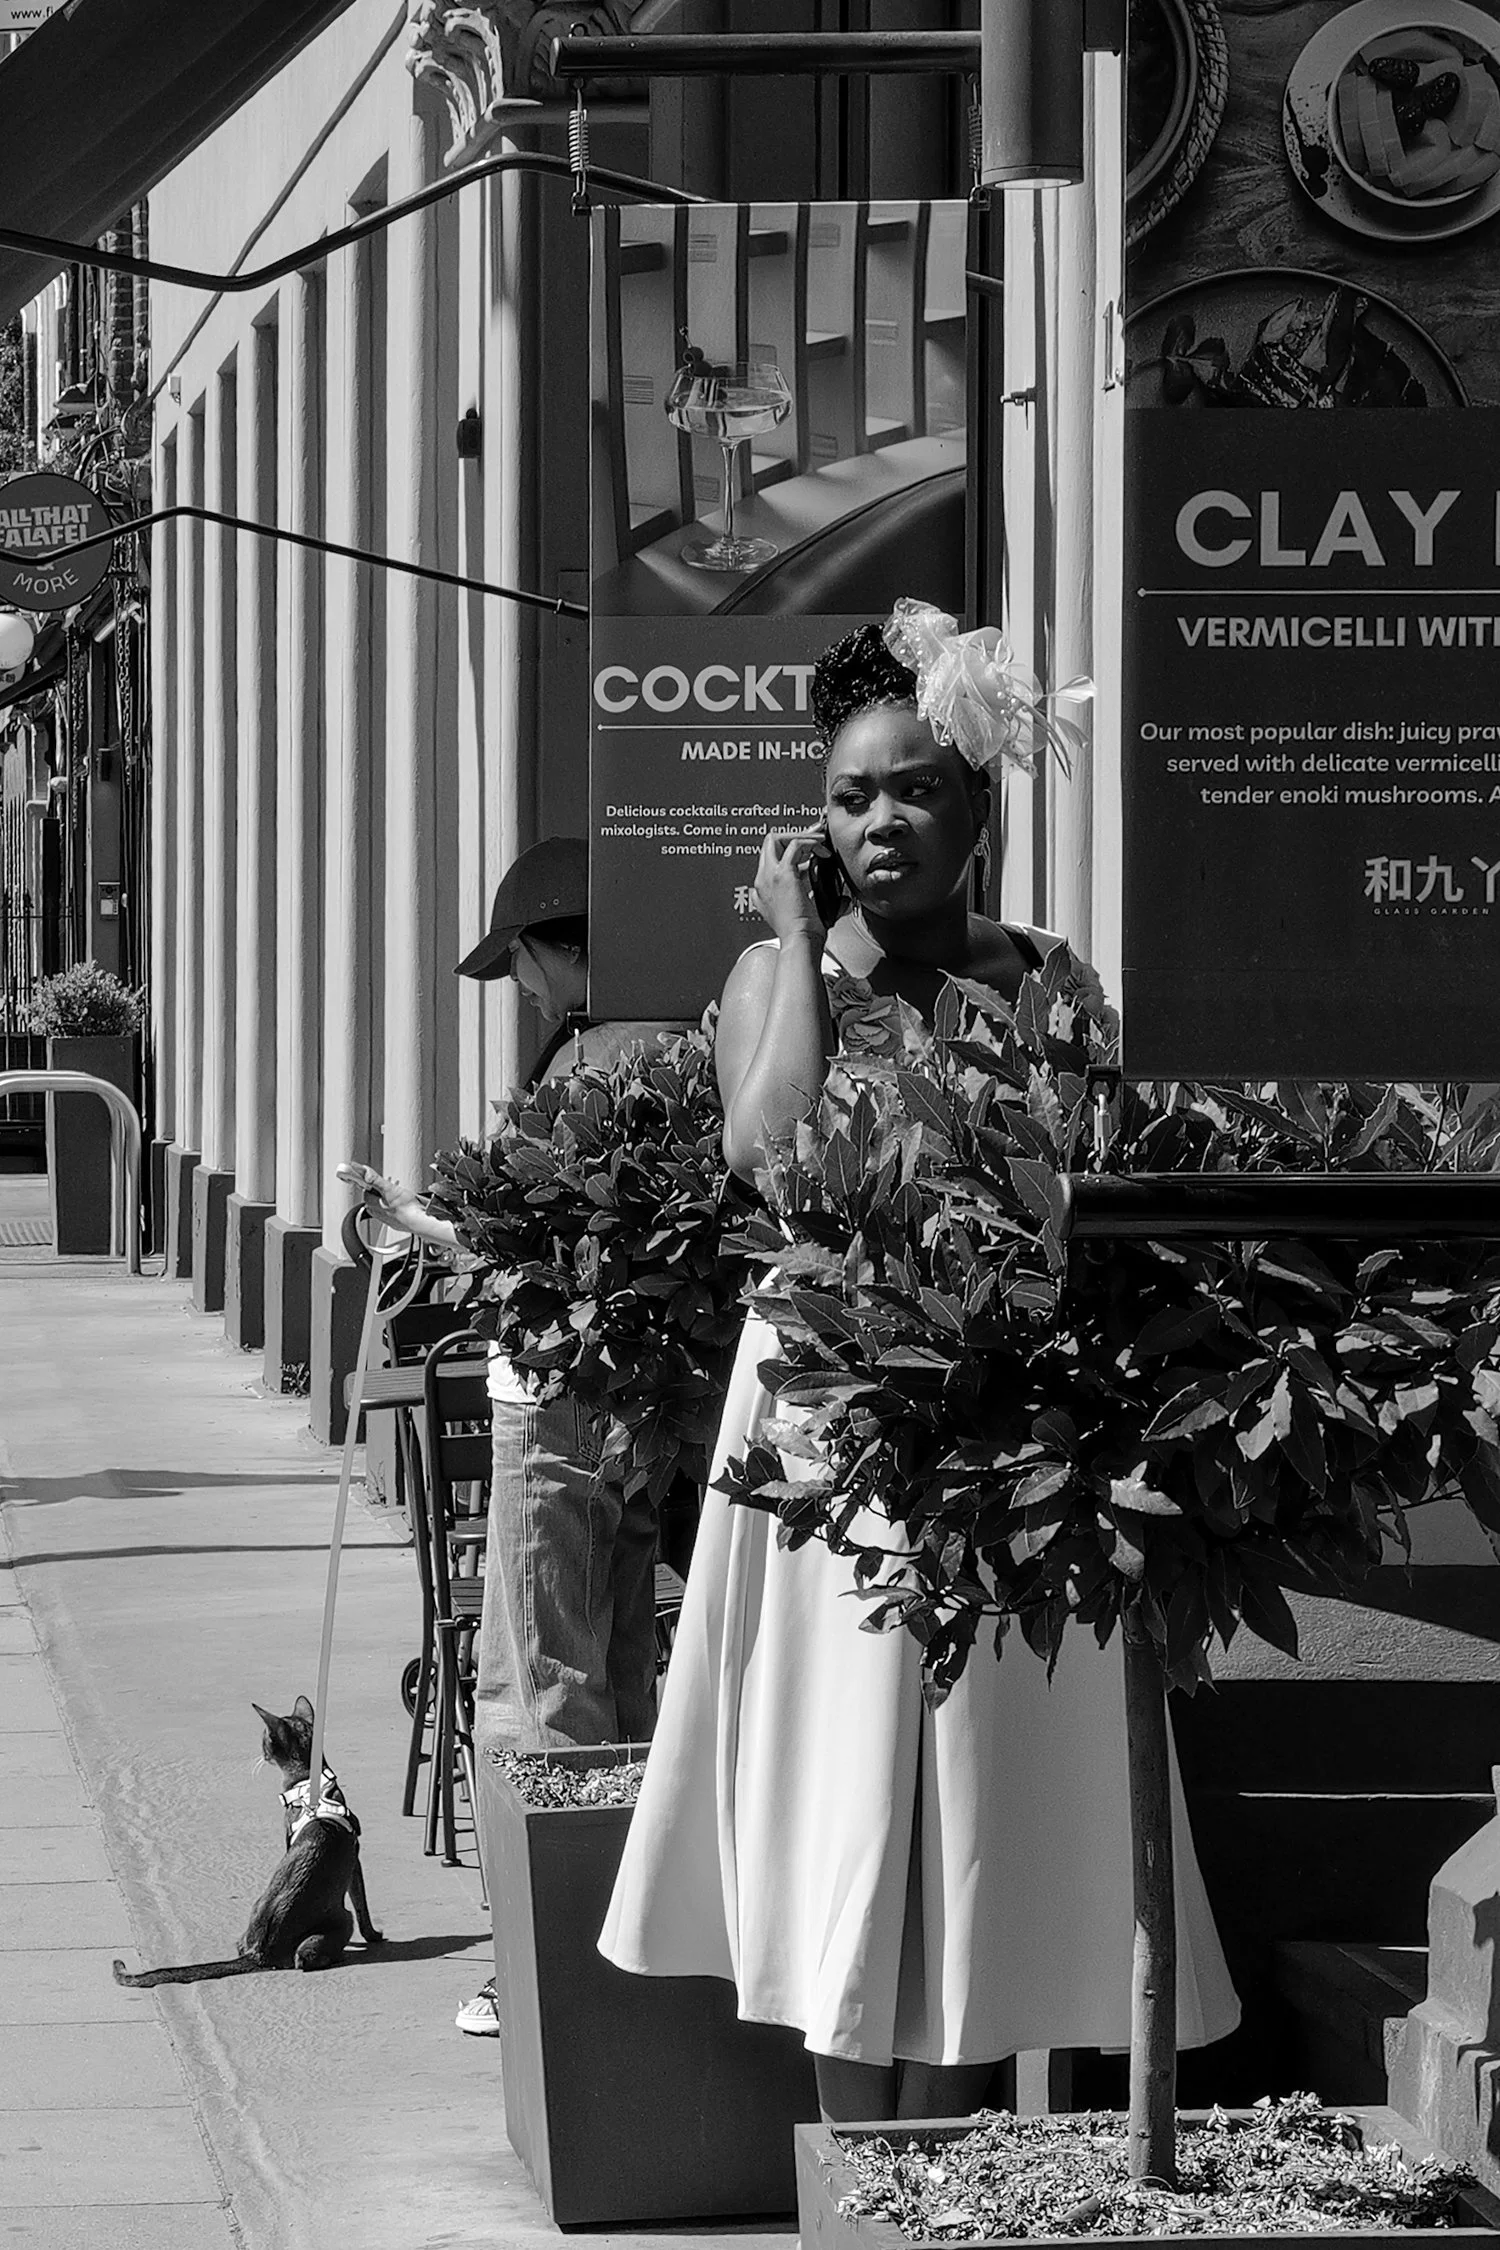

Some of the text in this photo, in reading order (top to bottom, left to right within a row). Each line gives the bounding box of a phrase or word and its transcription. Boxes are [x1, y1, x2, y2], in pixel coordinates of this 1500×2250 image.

[1175, 490, 1461, 567] CLAY
[13, 568, 79, 595] MORE
[1177, 616, 1405, 647] VERMICELLI
[593, 665, 817, 713] COCKT
[1140, 723, 1182, 741] Our
[1188, 724, 1245, 741] most
[1250, 721, 1338, 745] popular
[1343, 721, 1395, 741] dish:
[1396, 721, 1451, 745] juicy
[681, 741, 751, 760] MADE
[1166, 753, 1500, 772] served with delicate vermicelli
[1200, 785, 1274, 804] tender
[1279, 785, 1339, 804] enoki
[1345, 785, 1484, 804] mushrooms.
[606, 804, 667, 817] Delicious
[669, 804, 729, 817] cocktails
[731, 803, 780, 817] crafted
[600, 824, 680, 839] mixologists.
[682, 824, 723, 836] Come
[725, 823, 738, 836] in
[740, 823, 767, 836] and
[660, 842, 733, 857] something
[1430, 907, 1489, 915] GARDEN
